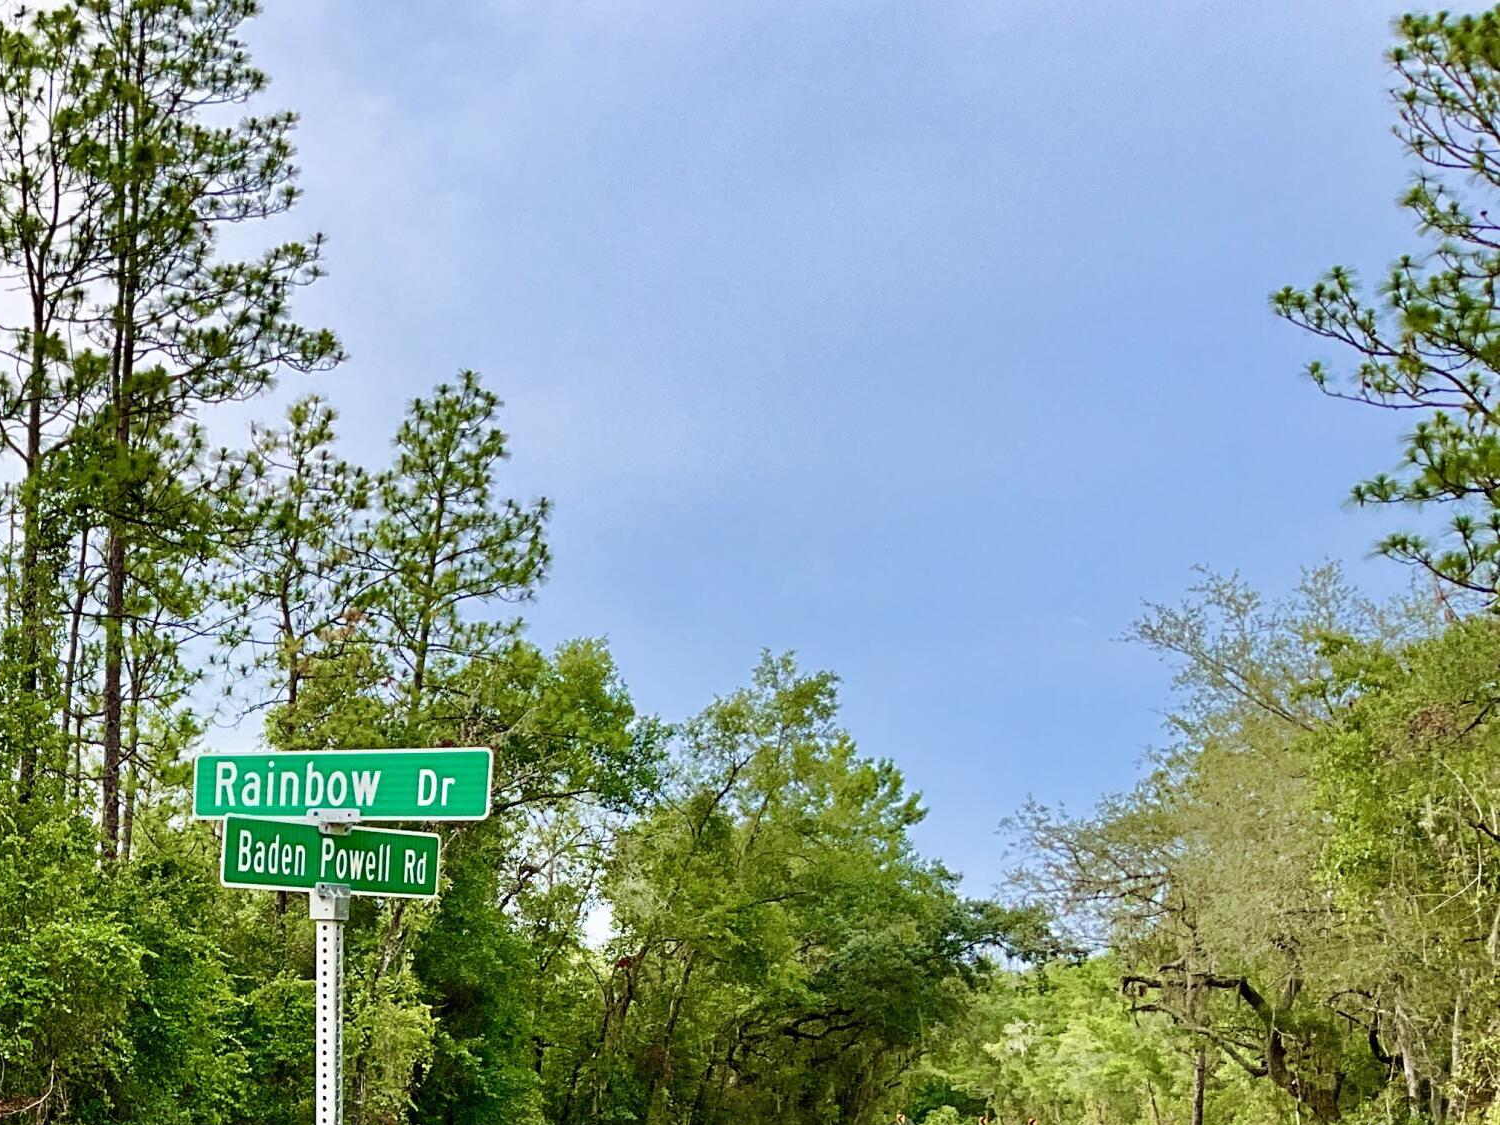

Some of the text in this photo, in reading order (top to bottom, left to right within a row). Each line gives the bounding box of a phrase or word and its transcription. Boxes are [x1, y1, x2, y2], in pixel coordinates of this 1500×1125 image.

[214, 760, 456, 807] Rainbow Dr
[237, 829, 427, 885] Baden Powell Rd
